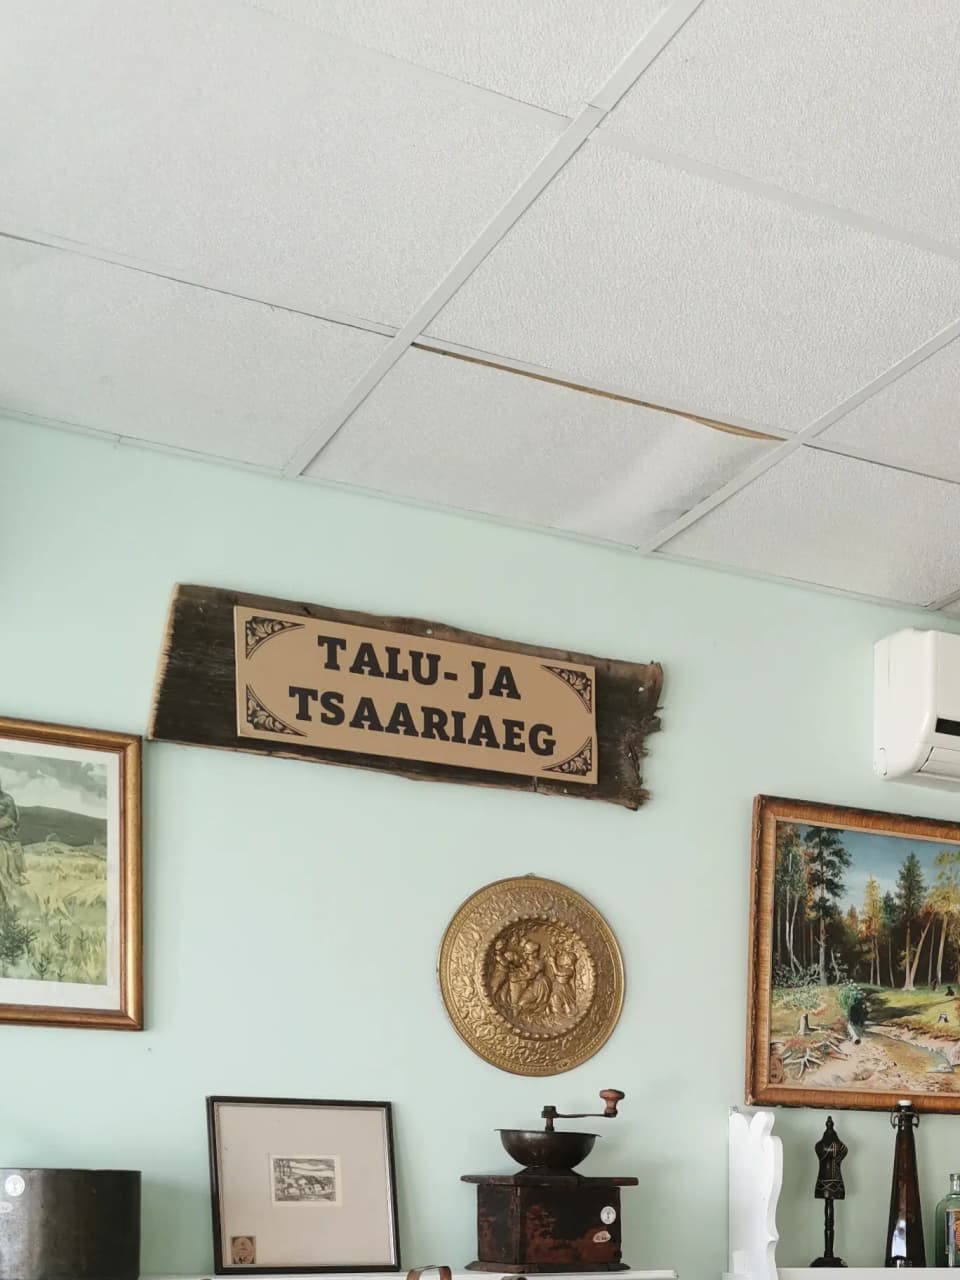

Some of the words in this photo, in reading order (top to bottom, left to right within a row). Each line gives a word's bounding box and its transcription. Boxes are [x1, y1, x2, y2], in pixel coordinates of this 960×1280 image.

[317, 634, 459, 686] TALU-
[468, 660, 522, 700] JA
[288, 685, 557, 757] TSAARIAEG
